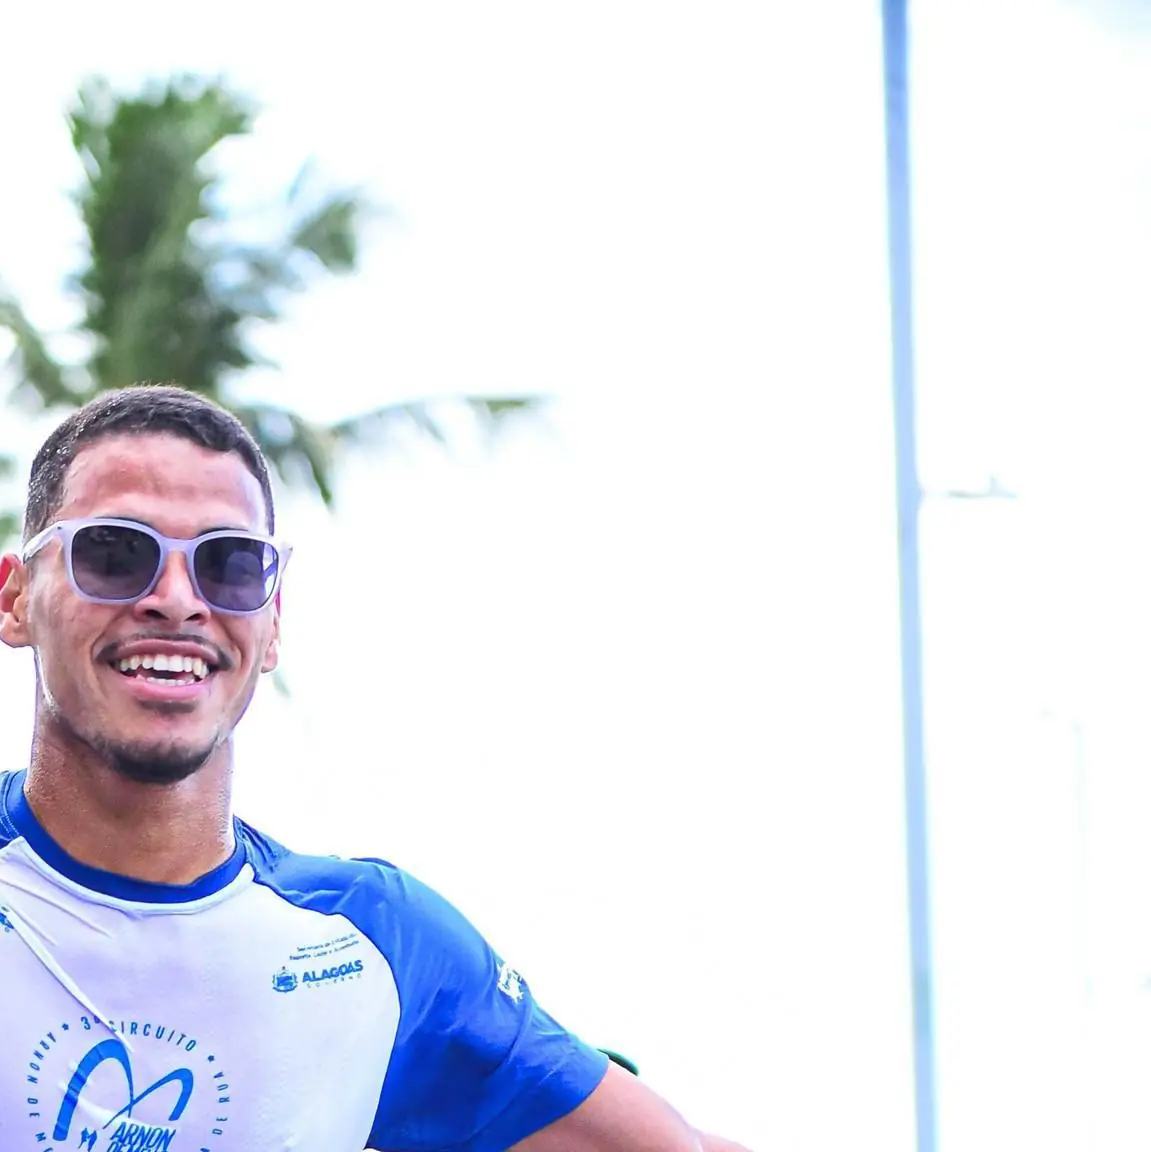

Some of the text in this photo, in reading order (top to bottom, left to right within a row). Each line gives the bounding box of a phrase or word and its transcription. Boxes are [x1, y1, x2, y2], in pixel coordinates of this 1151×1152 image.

[302, 960, 363, 983] ALAGOAS
[108, 1020, 197, 1051] CIRCUITO
[27, 1032, 57, 1084] ARNON
[213, 1071, 230, 1103] RUA
[27, 1097, 40, 1118] DE
[109, 1121, 177, 1151] ARNON
[212, 1116, 228, 1135] DE
